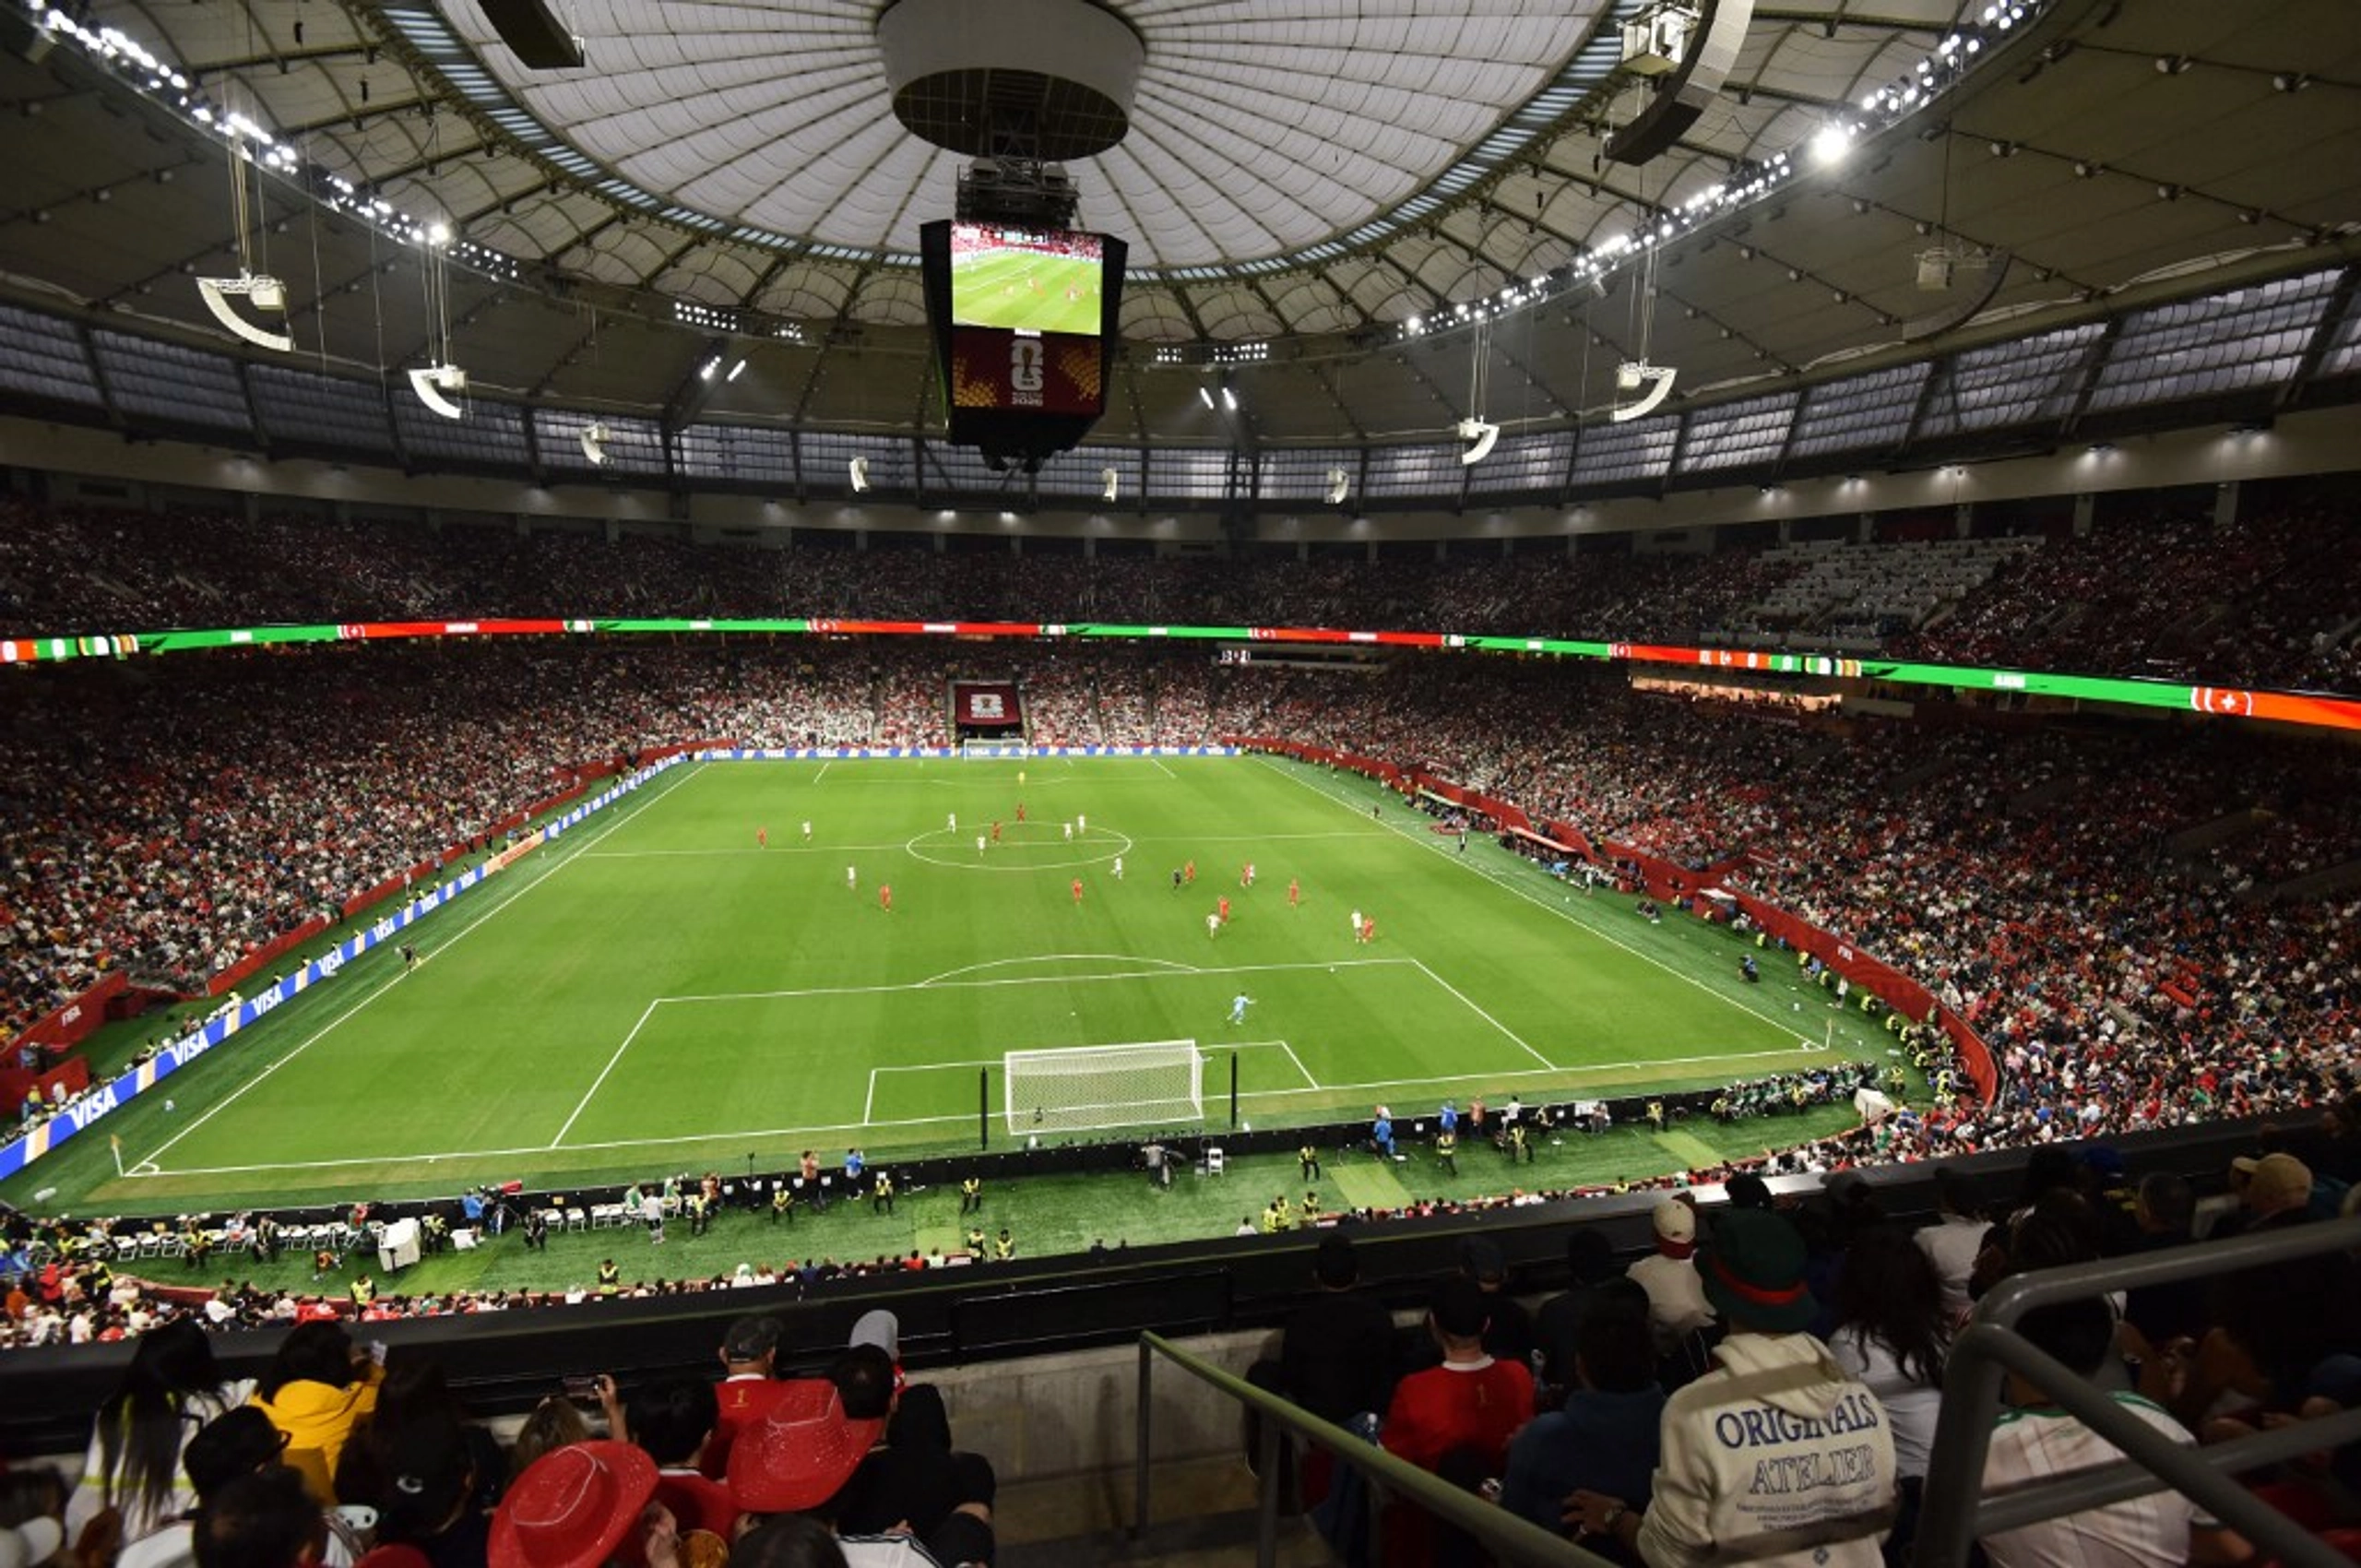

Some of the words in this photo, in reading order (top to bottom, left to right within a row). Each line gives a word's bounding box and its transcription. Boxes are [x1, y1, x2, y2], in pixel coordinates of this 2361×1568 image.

[374, 918, 396, 941] VISA
[317, 947, 344, 976] VISA
[251, 984, 283, 1016] VISA
[171, 1029, 210, 1066] VISA
[67, 1085, 118, 1131] VISA
[1750, 1444, 1876, 1495] ATELIER
